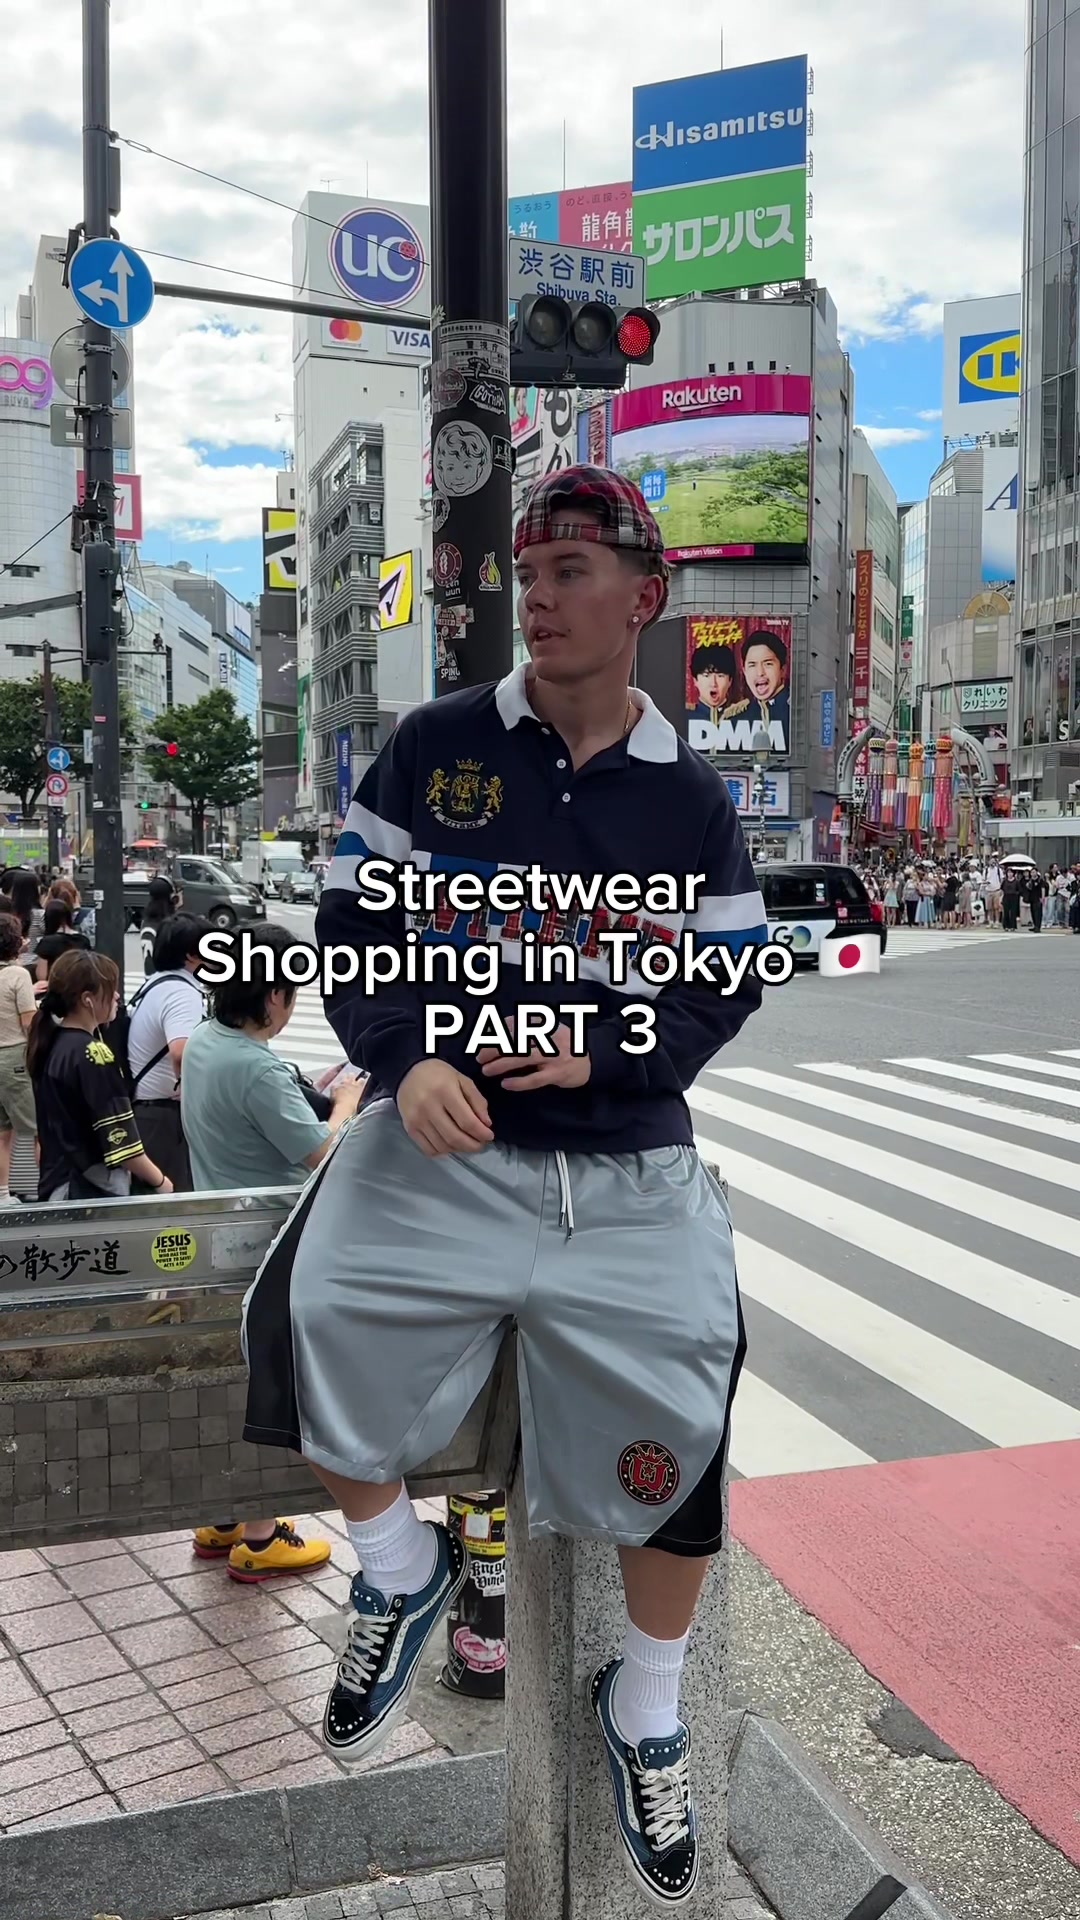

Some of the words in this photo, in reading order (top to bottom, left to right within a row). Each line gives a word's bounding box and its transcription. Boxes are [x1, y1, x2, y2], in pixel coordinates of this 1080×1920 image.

[635, 106, 804, 152] Hisamitsu
[565, 190, 632, 208] のど、直接、う
[642, 204, 796, 266] サロンパス
[341, 229, 415, 283] UC
[518, 246, 635, 290] 渋谷駅前
[536, 281, 590, 302] Shibuya
[595, 288, 622, 306] Sta.
[389, 329, 431, 349] VISA
[662, 384, 742, 411] Rakuten
[677, 549, 702, 559] Rakuten
[703, 547, 723, 556] Vision
[858, 553, 870, 641] クスリのことなら
[855, 646, 868, 700] 三千里
[963, 698, 1007, 710] クリニック
[973, 685, 1007, 698] れいわ
[687, 719, 787, 752] DMM
[154, 1233, 191, 1249] JESUS
